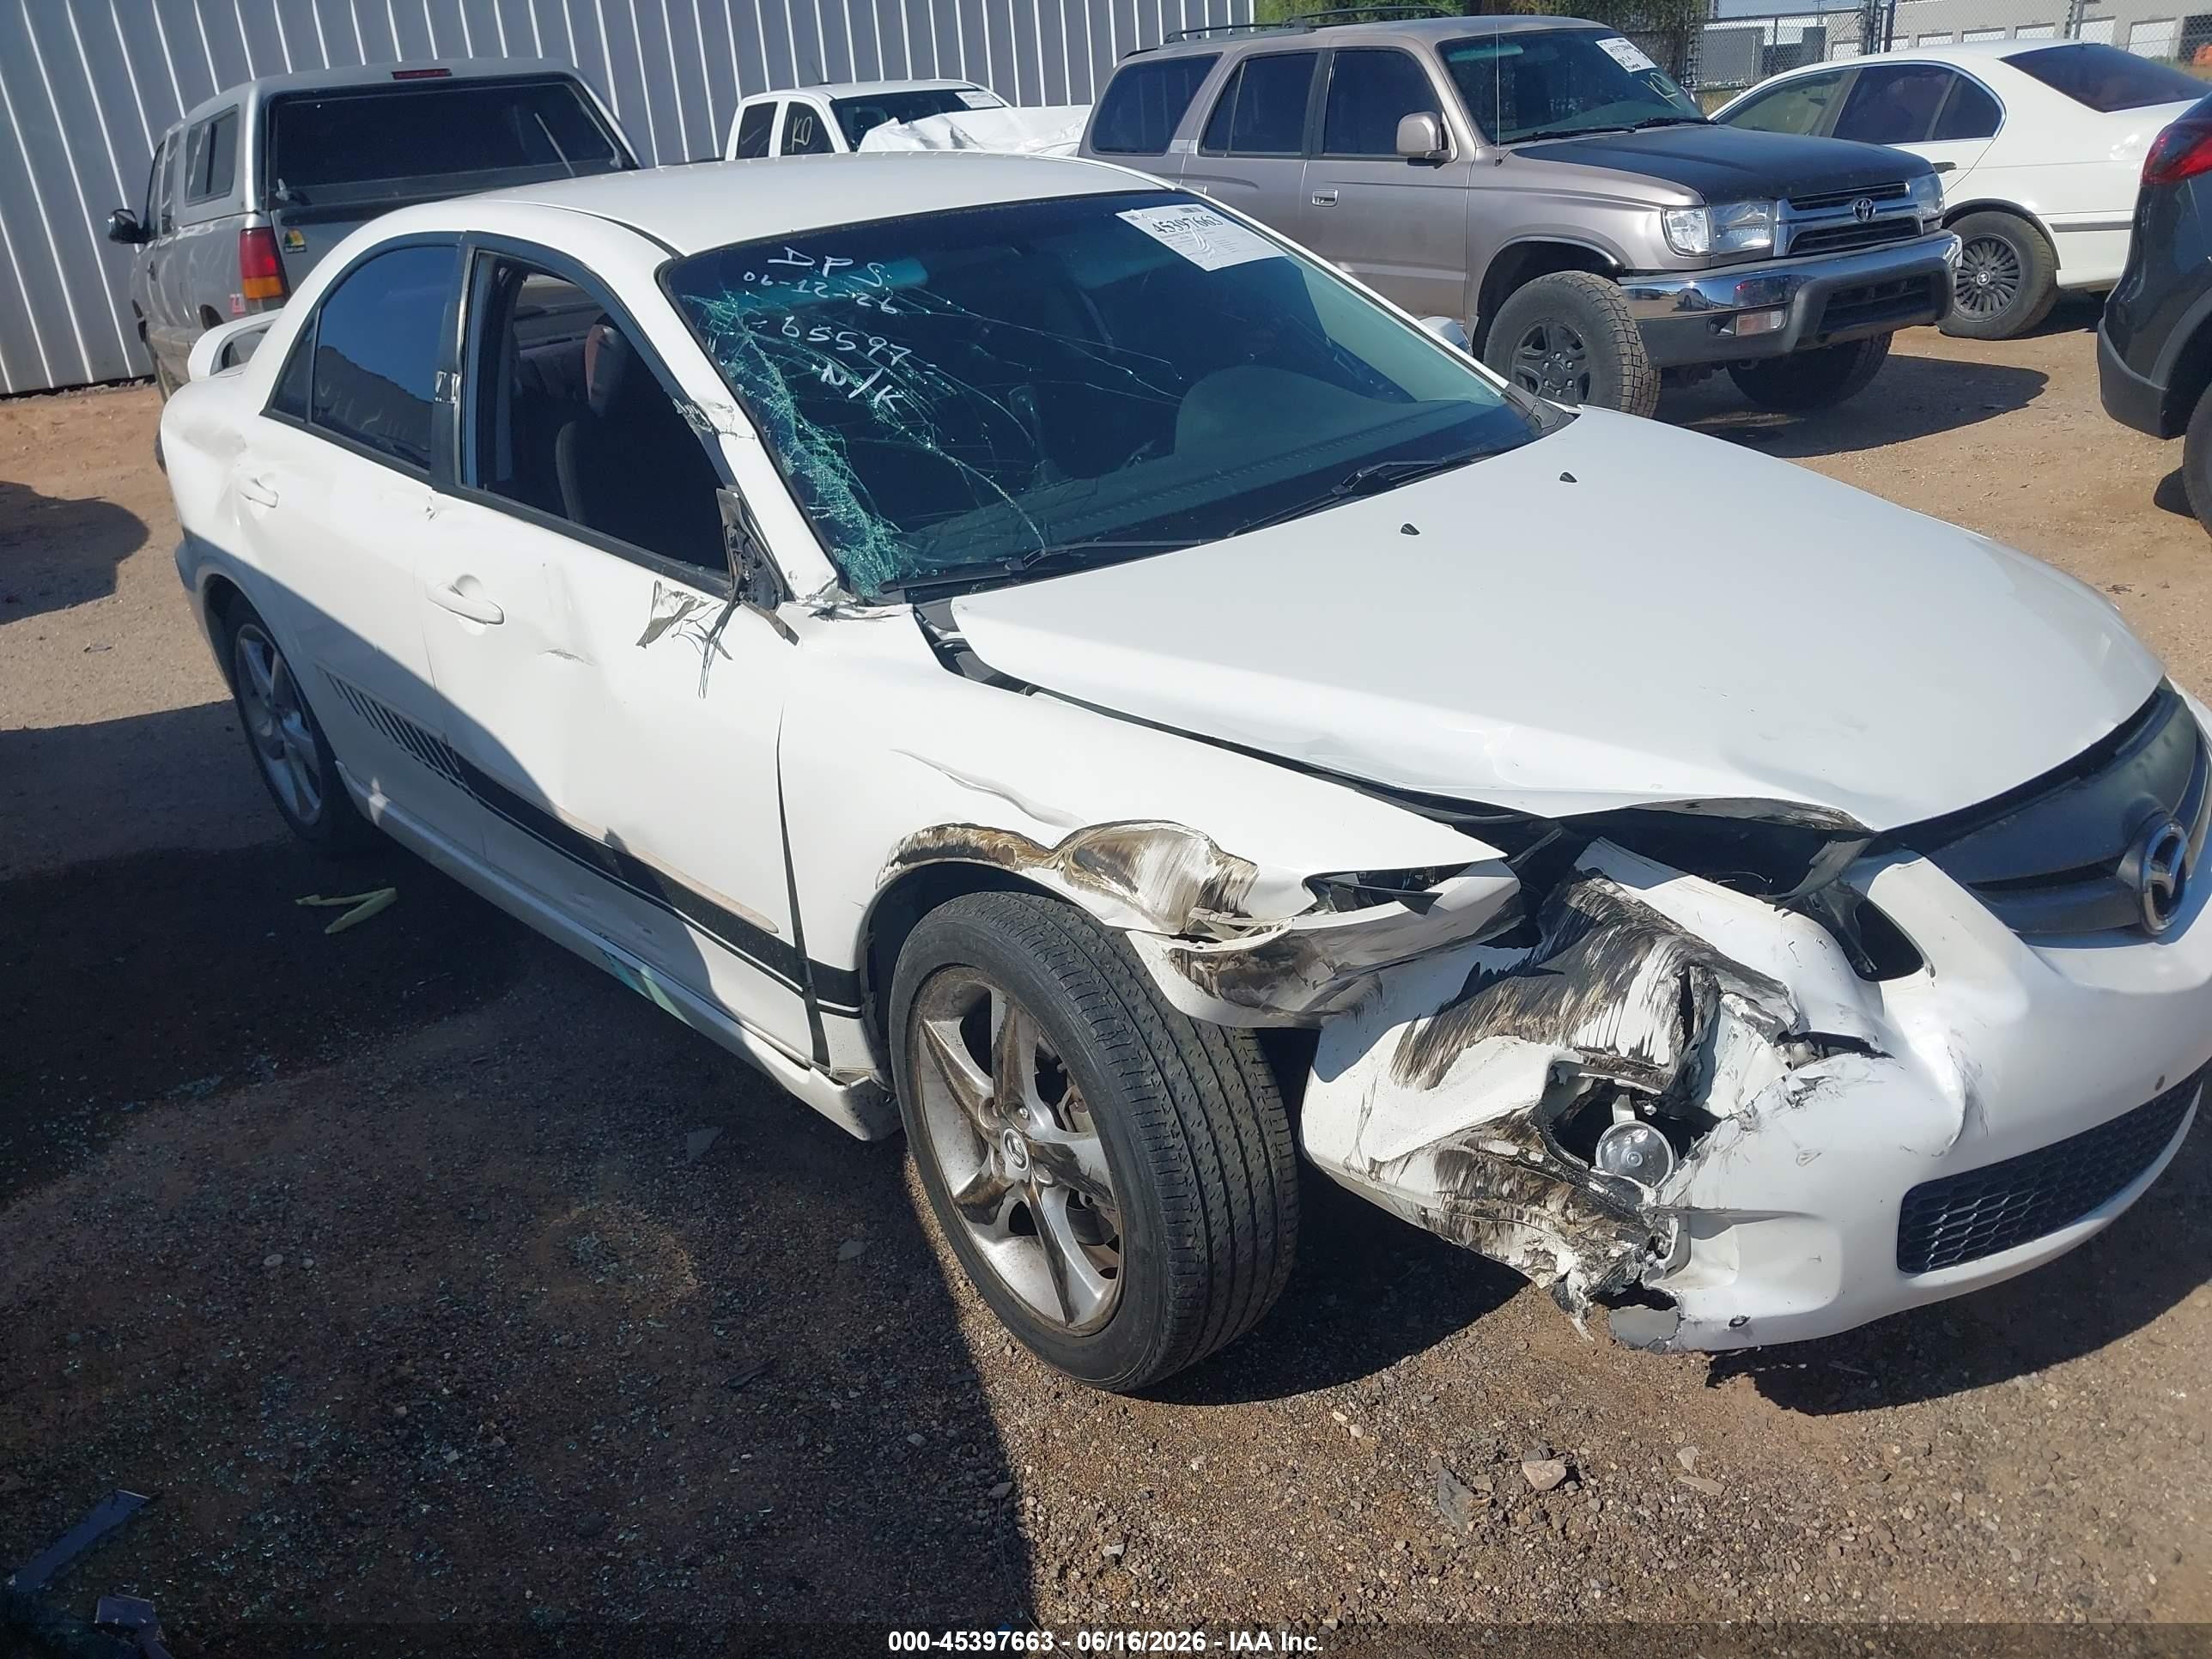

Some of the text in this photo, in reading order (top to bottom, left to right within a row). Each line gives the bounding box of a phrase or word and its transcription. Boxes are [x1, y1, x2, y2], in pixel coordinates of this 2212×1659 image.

[1152, 215, 1224, 234] 45397663
[767, 246, 886, 288] DPS
[743, 271, 898, 315] 06-12-26
[820, 364, 904, 412] N/K
